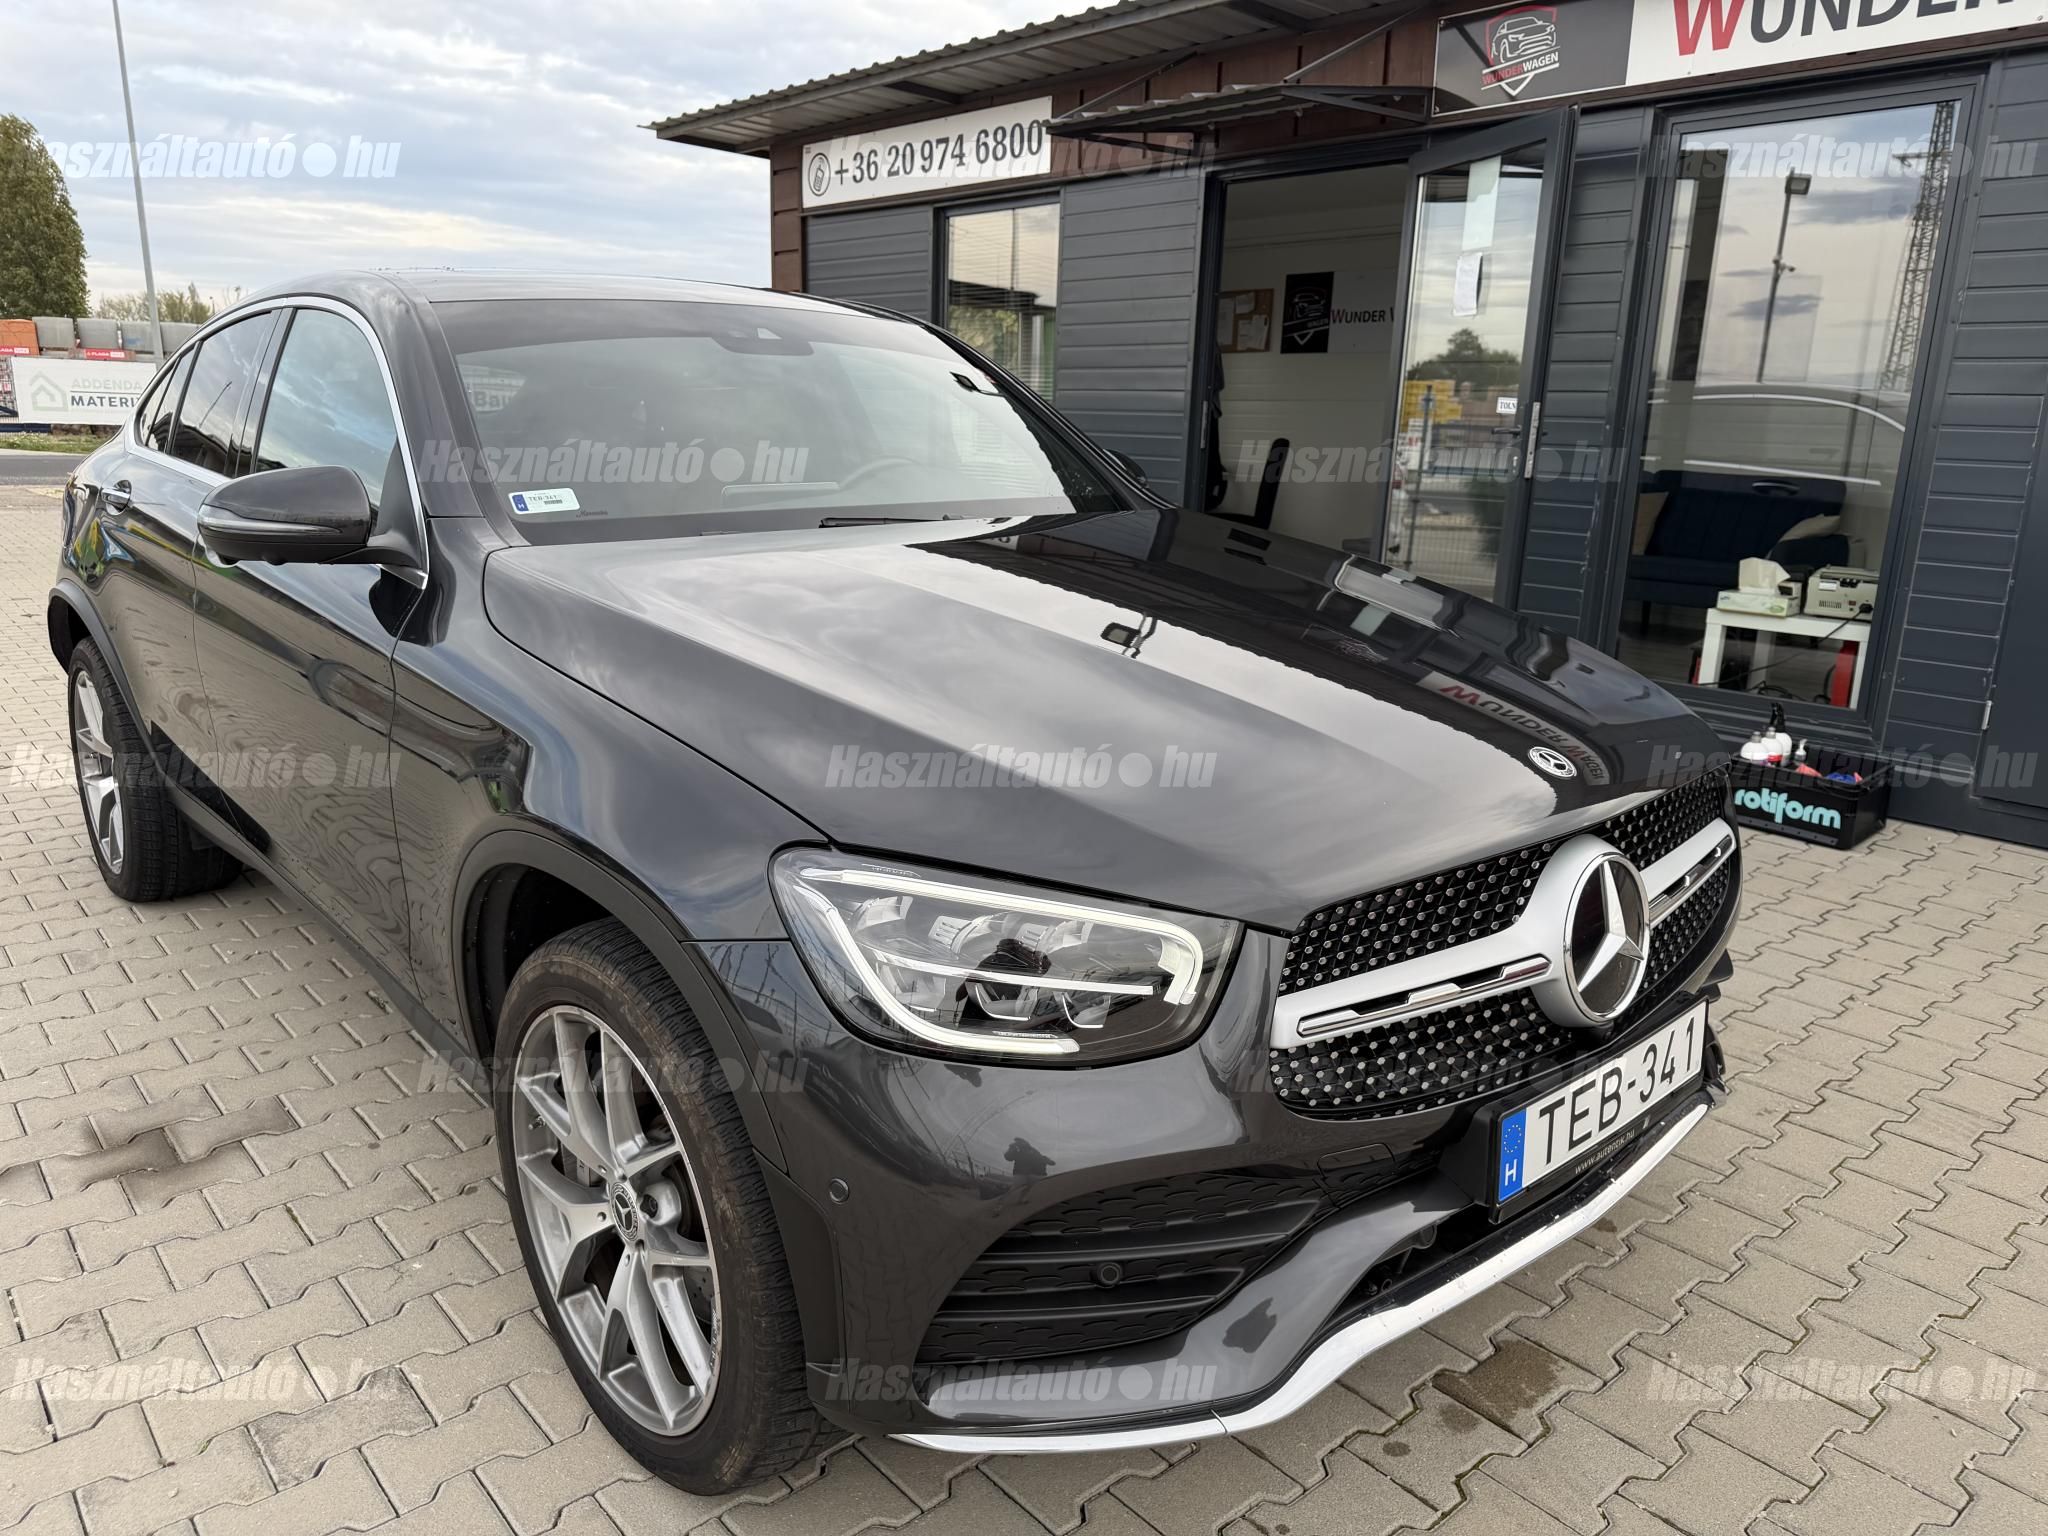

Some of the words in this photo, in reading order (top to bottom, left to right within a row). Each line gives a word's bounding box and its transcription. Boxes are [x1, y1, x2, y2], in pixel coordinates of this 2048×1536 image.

[834, 149, 879, 185] +36
[887, 142, 915, 177] 20
[920, 134, 966, 173] 974
[975, 119, 1043, 164] 6800
[71, 378, 143, 390] ADDENDA
[71, 395, 138, 408] MATERI
[1734, 788, 1841, 829] rotiform
[1539, 1016, 1695, 1165] TEB-341
[1504, 1158, 1517, 1186] H
